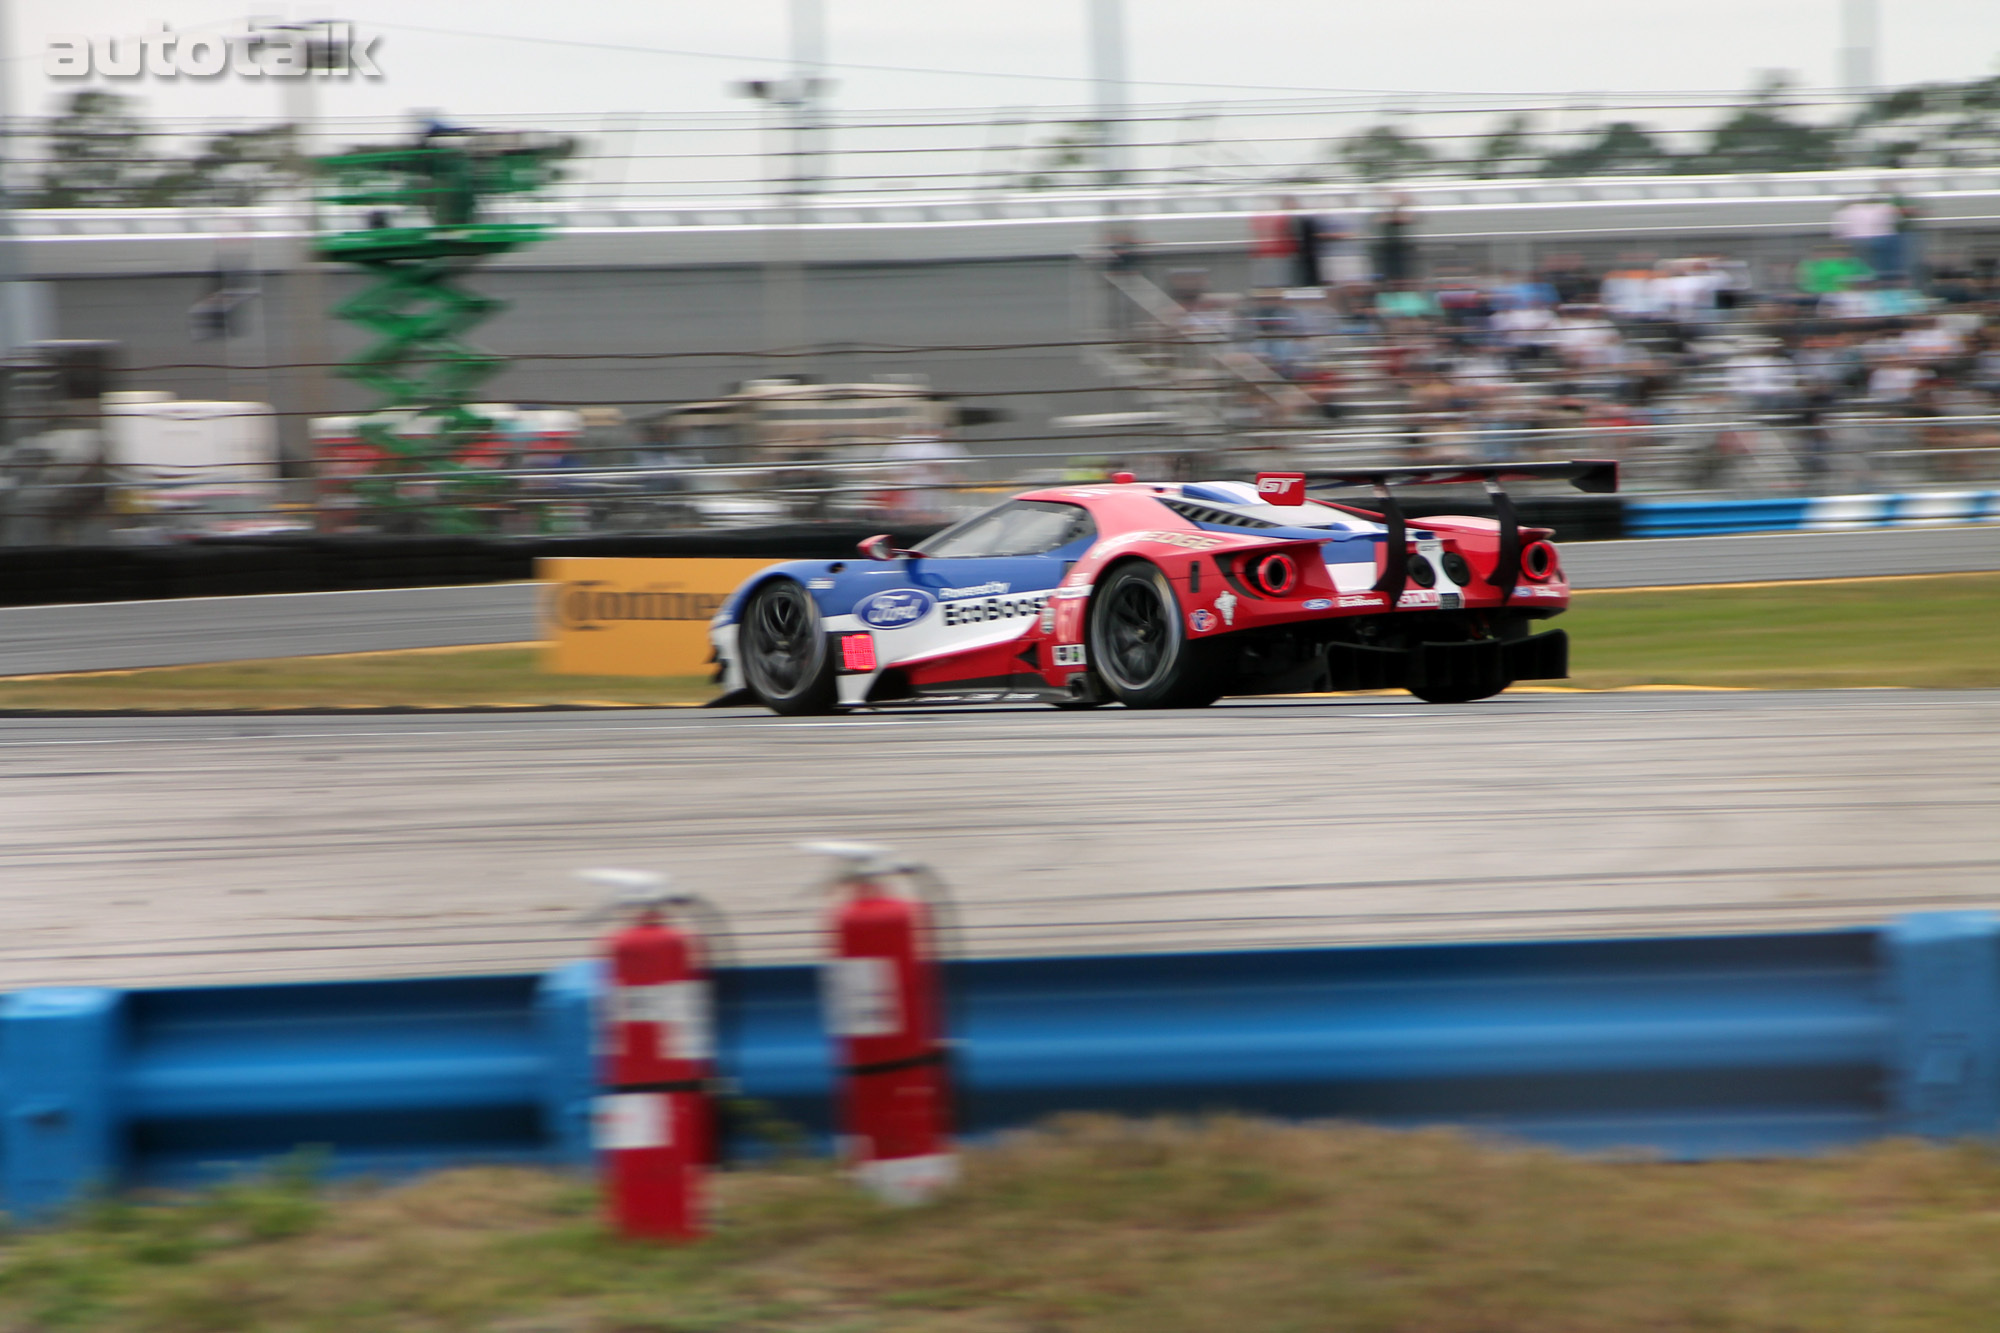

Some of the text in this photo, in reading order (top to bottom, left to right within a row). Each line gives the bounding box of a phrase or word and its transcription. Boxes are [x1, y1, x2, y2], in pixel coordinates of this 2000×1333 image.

[1258, 477, 1303, 495] GT
[1140, 531, 1225, 550] EDGE
[866, 594, 925, 624] Ford
[942, 595, 1051, 626] EcoBoos
